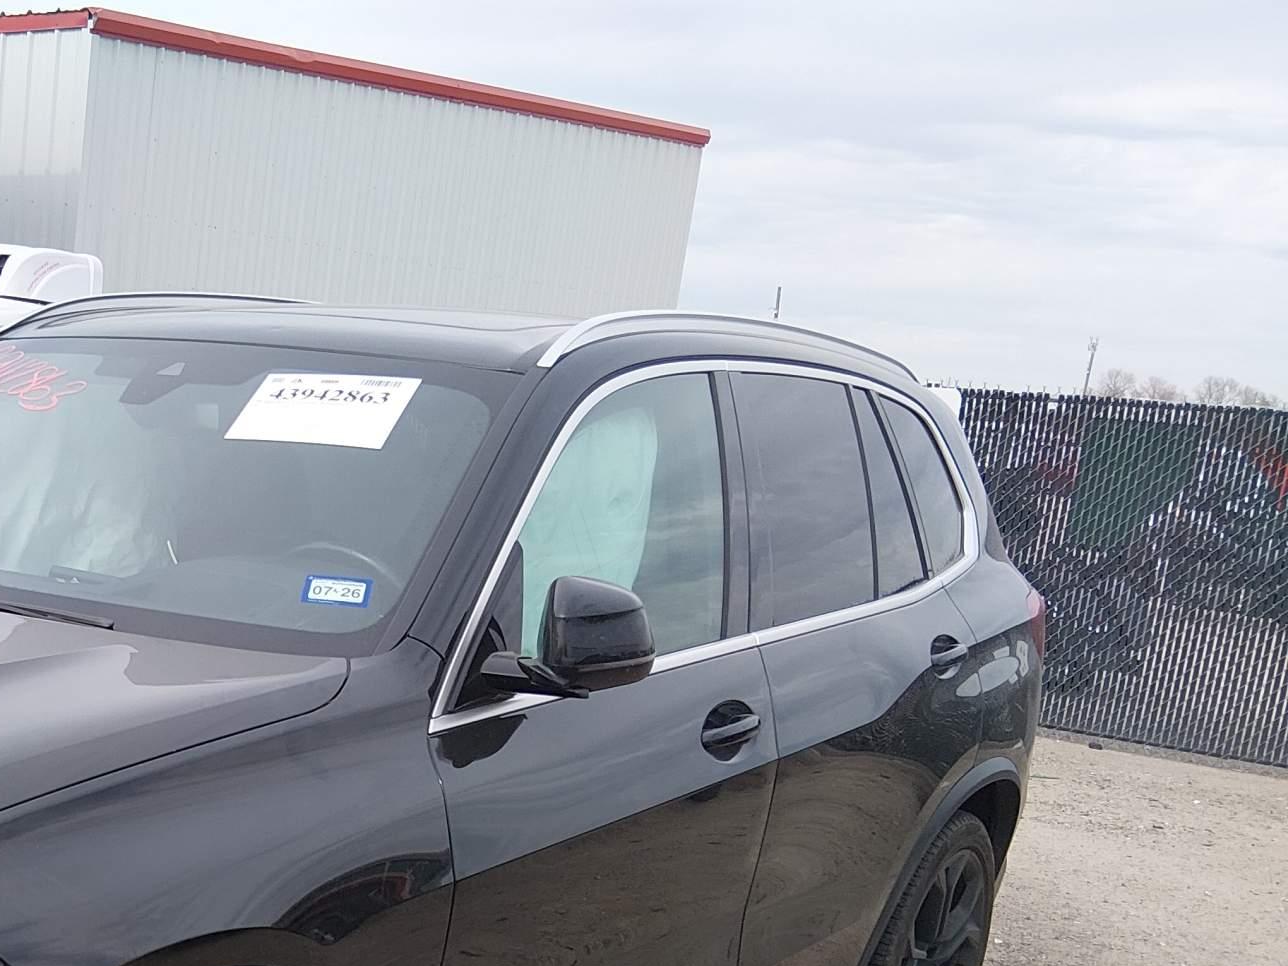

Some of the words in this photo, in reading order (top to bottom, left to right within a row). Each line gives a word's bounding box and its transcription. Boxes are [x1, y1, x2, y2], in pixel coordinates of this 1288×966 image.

[269, 387, 391, 405] 43942863
[312, 585, 333, 596] 07
[340, 587, 361, 599] 26
